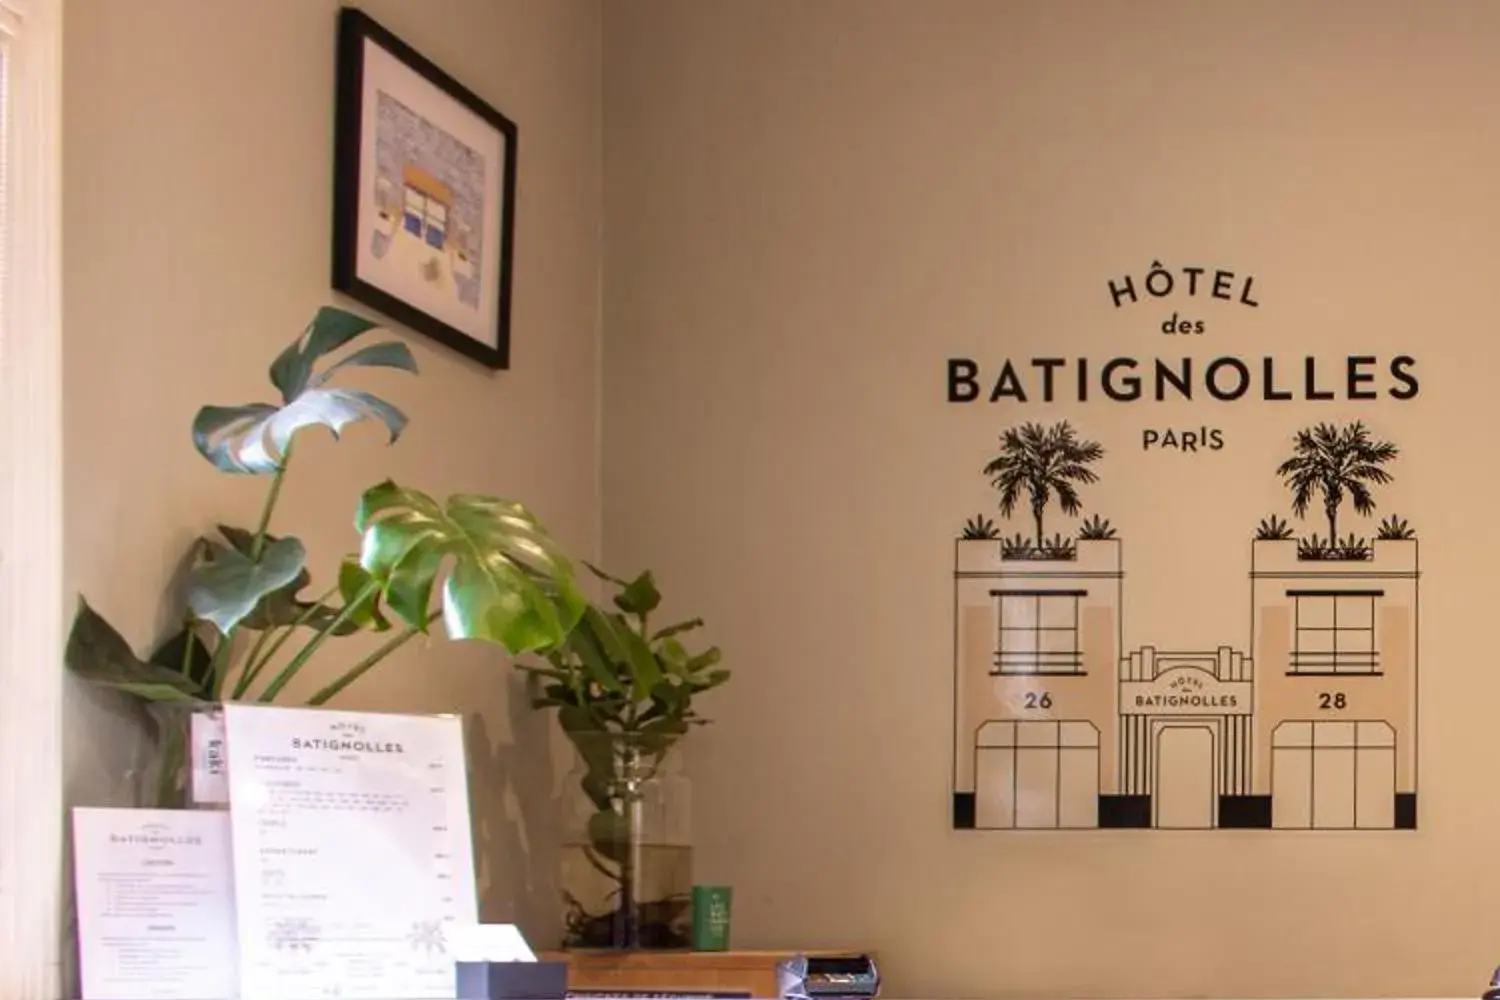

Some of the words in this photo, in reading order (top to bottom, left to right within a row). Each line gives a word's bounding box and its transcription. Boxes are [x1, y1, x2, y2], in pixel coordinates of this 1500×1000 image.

[1107, 260, 1259, 308] HÔTEL
[1161, 312, 1205, 335] des
[947, 355, 1419, 403] BATIGNOLLES
[1025, 692, 1053, 710] 26
[1135, 695, 1237, 707] BATIGNOLLES
[1319, 692, 1347, 710] 28
[292, 737, 404, 753] BATIGNOLLES
